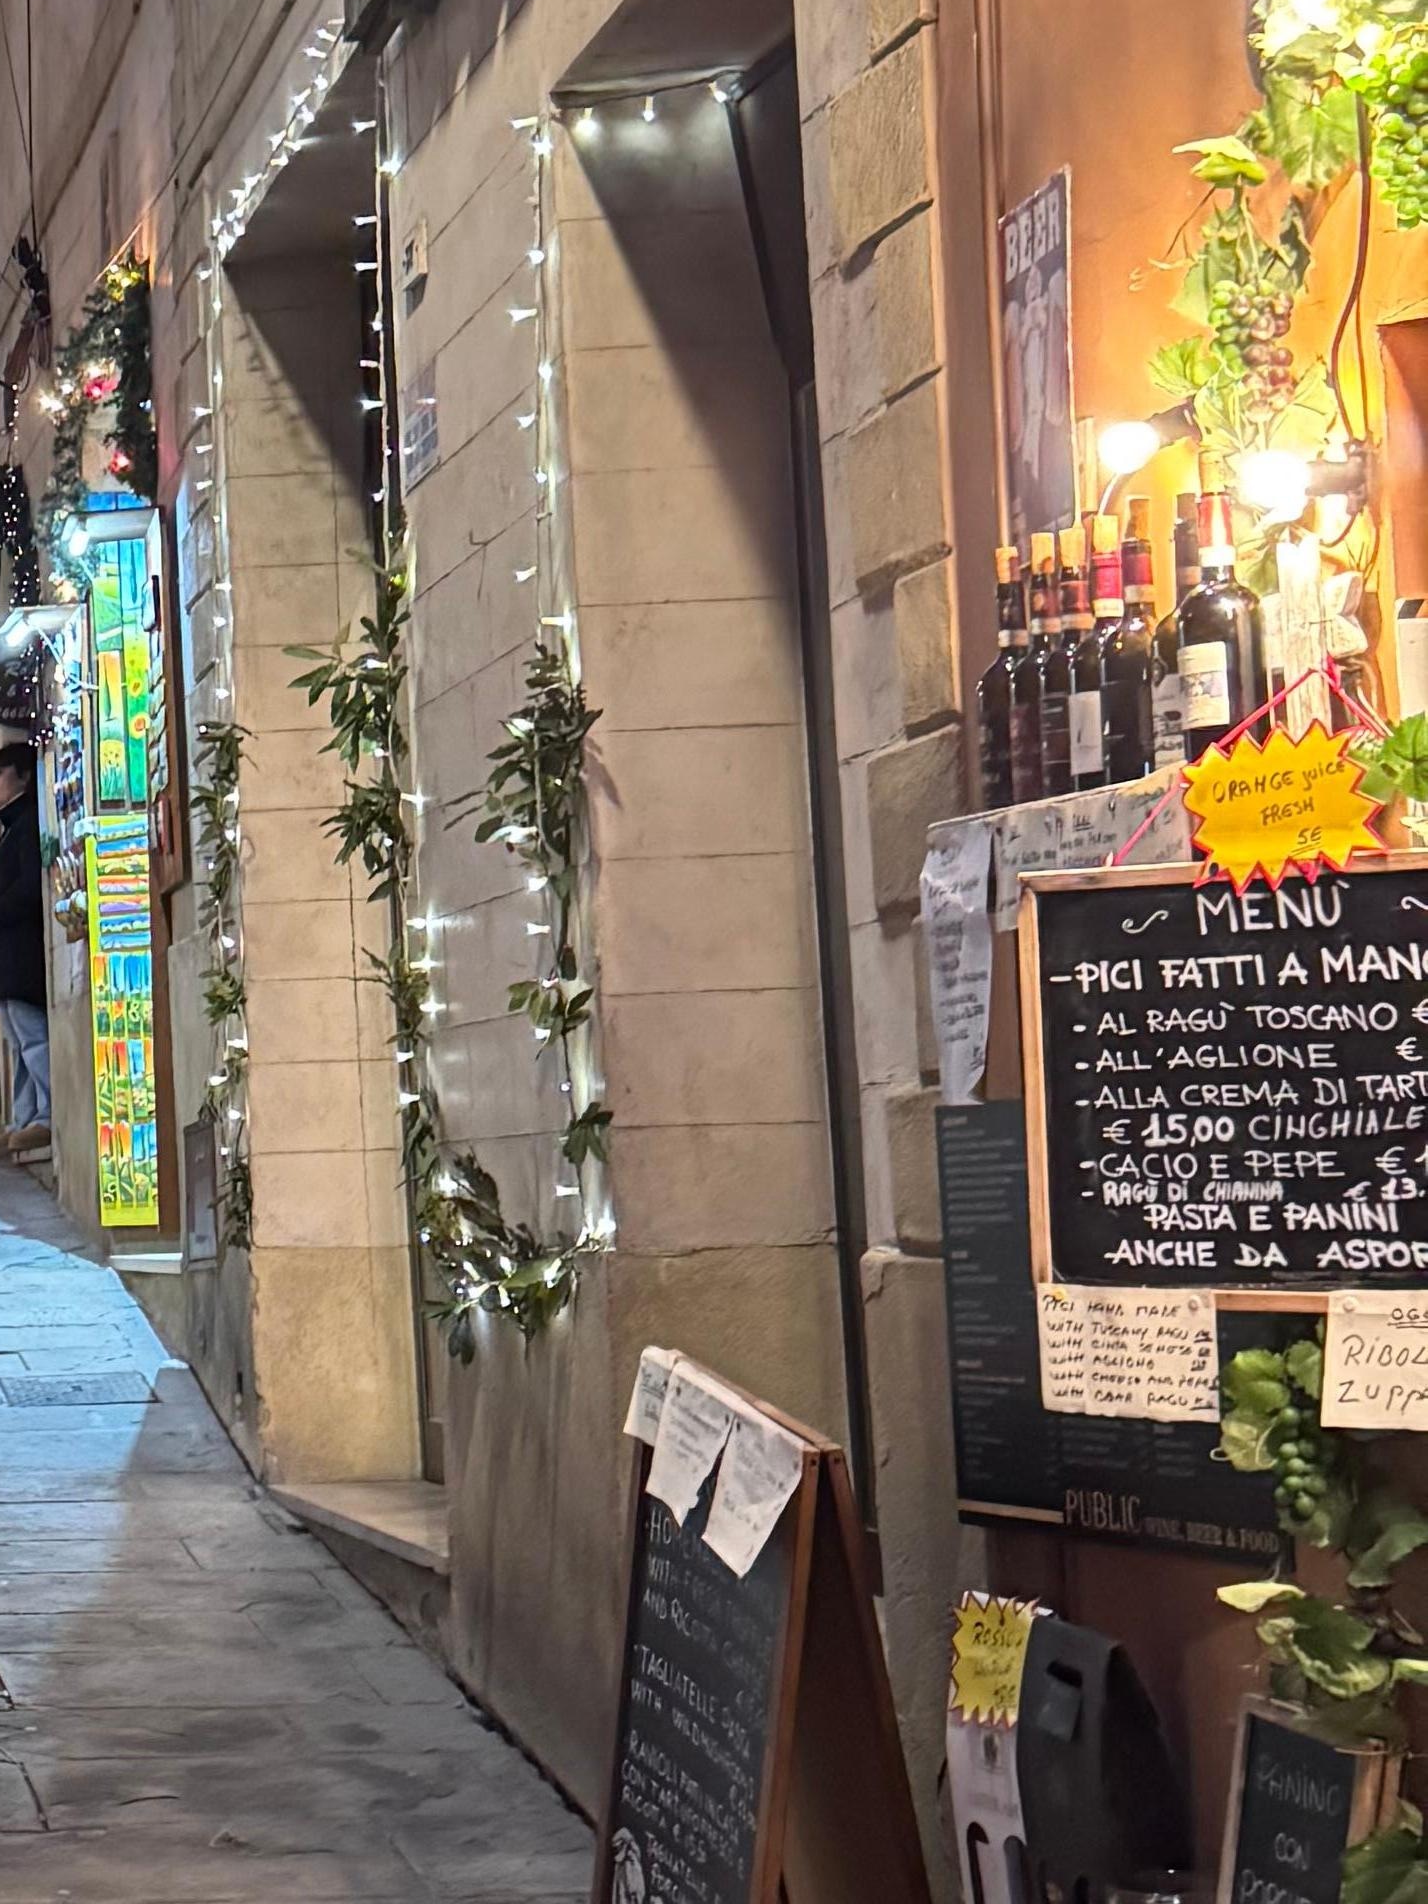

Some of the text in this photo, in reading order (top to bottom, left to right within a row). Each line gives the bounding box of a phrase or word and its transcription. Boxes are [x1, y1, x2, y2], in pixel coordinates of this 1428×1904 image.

[1005, 188, 1060, 283] BEER
[1212, 770, 1294, 803] ORANGE
[1260, 797, 1315, 826] FRESH
[1196, 880, 1350, 936] MENÙ
[1158, 954, 1266, 989] FATTI
[1278, 951, 1308, 987] A
[1320, 942, 1428, 985] MAN
[1146, 1001, 1235, 1033] RAGÙ
[1244, 1002, 1398, 1033] TOSCANO
[1094, 1085, 1170, 1110] ALLA
[1180, 1079, 1299, 1108] CREMA
[1313, 1078, 1347, 1105] DI
[1102, 1118, 1132, 1145] €
[1099, 1153, 1199, 1179] CACIO
[1211, 1154, 1229, 1180] E
[1244, 1150, 1346, 1178] PEPE
[1375, 1146, 1407, 1176] €
[1143, 1203, 1400, 1233] PASTA E PANINI
[1104, 1239, 1218, 1267] ANCHE
[1234, 1242, 1288, 1267] DA
[1391, 1308, 1428, 1321] OG
[1065, 1488, 1141, 1532] PUBLIC
[1240, 1528, 1279, 1553] FOOD
[641, 1645, 716, 1724] TAGLIATELLE
[1275, 1832, 1309, 1871] CON
